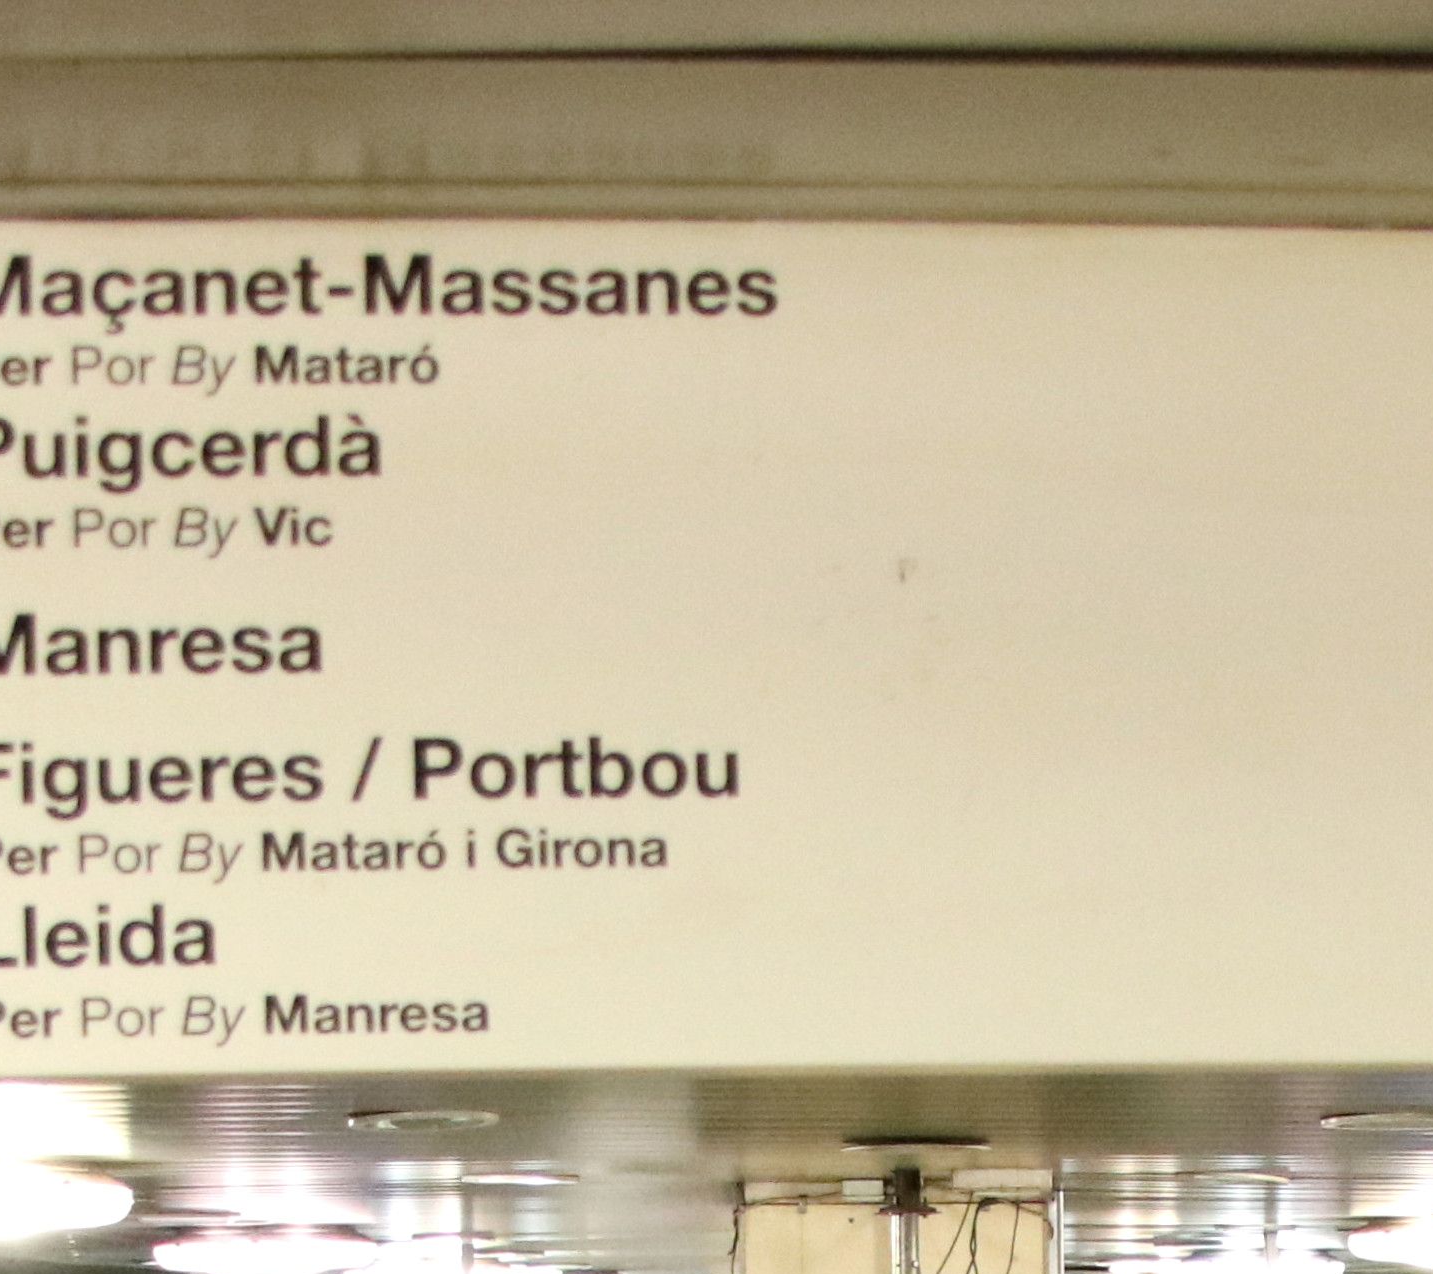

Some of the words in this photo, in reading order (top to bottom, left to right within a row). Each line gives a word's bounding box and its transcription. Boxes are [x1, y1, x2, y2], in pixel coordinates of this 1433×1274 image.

[72, 346, 155, 385] Por
[172, 345, 236, 393] By
[253, 344, 440, 386] Mataró
[73, 508, 156, 549] Por
[174, 507, 237, 554] By
[253, 506, 333, 548] Vic
[352, 736, 382, 801] /
[413, 736, 740, 800] Portbou
[79, 834, 161, 874] Por
[179, 833, 242, 882] By
[261, 830, 446, 873] Mataró
[466, 829, 476, 868] i
[495, 827, 668, 869] Girona
[82, 998, 164, 1038] Por
[182, 996, 245, 1042] By
[264, 993, 489, 1035] Manresa
